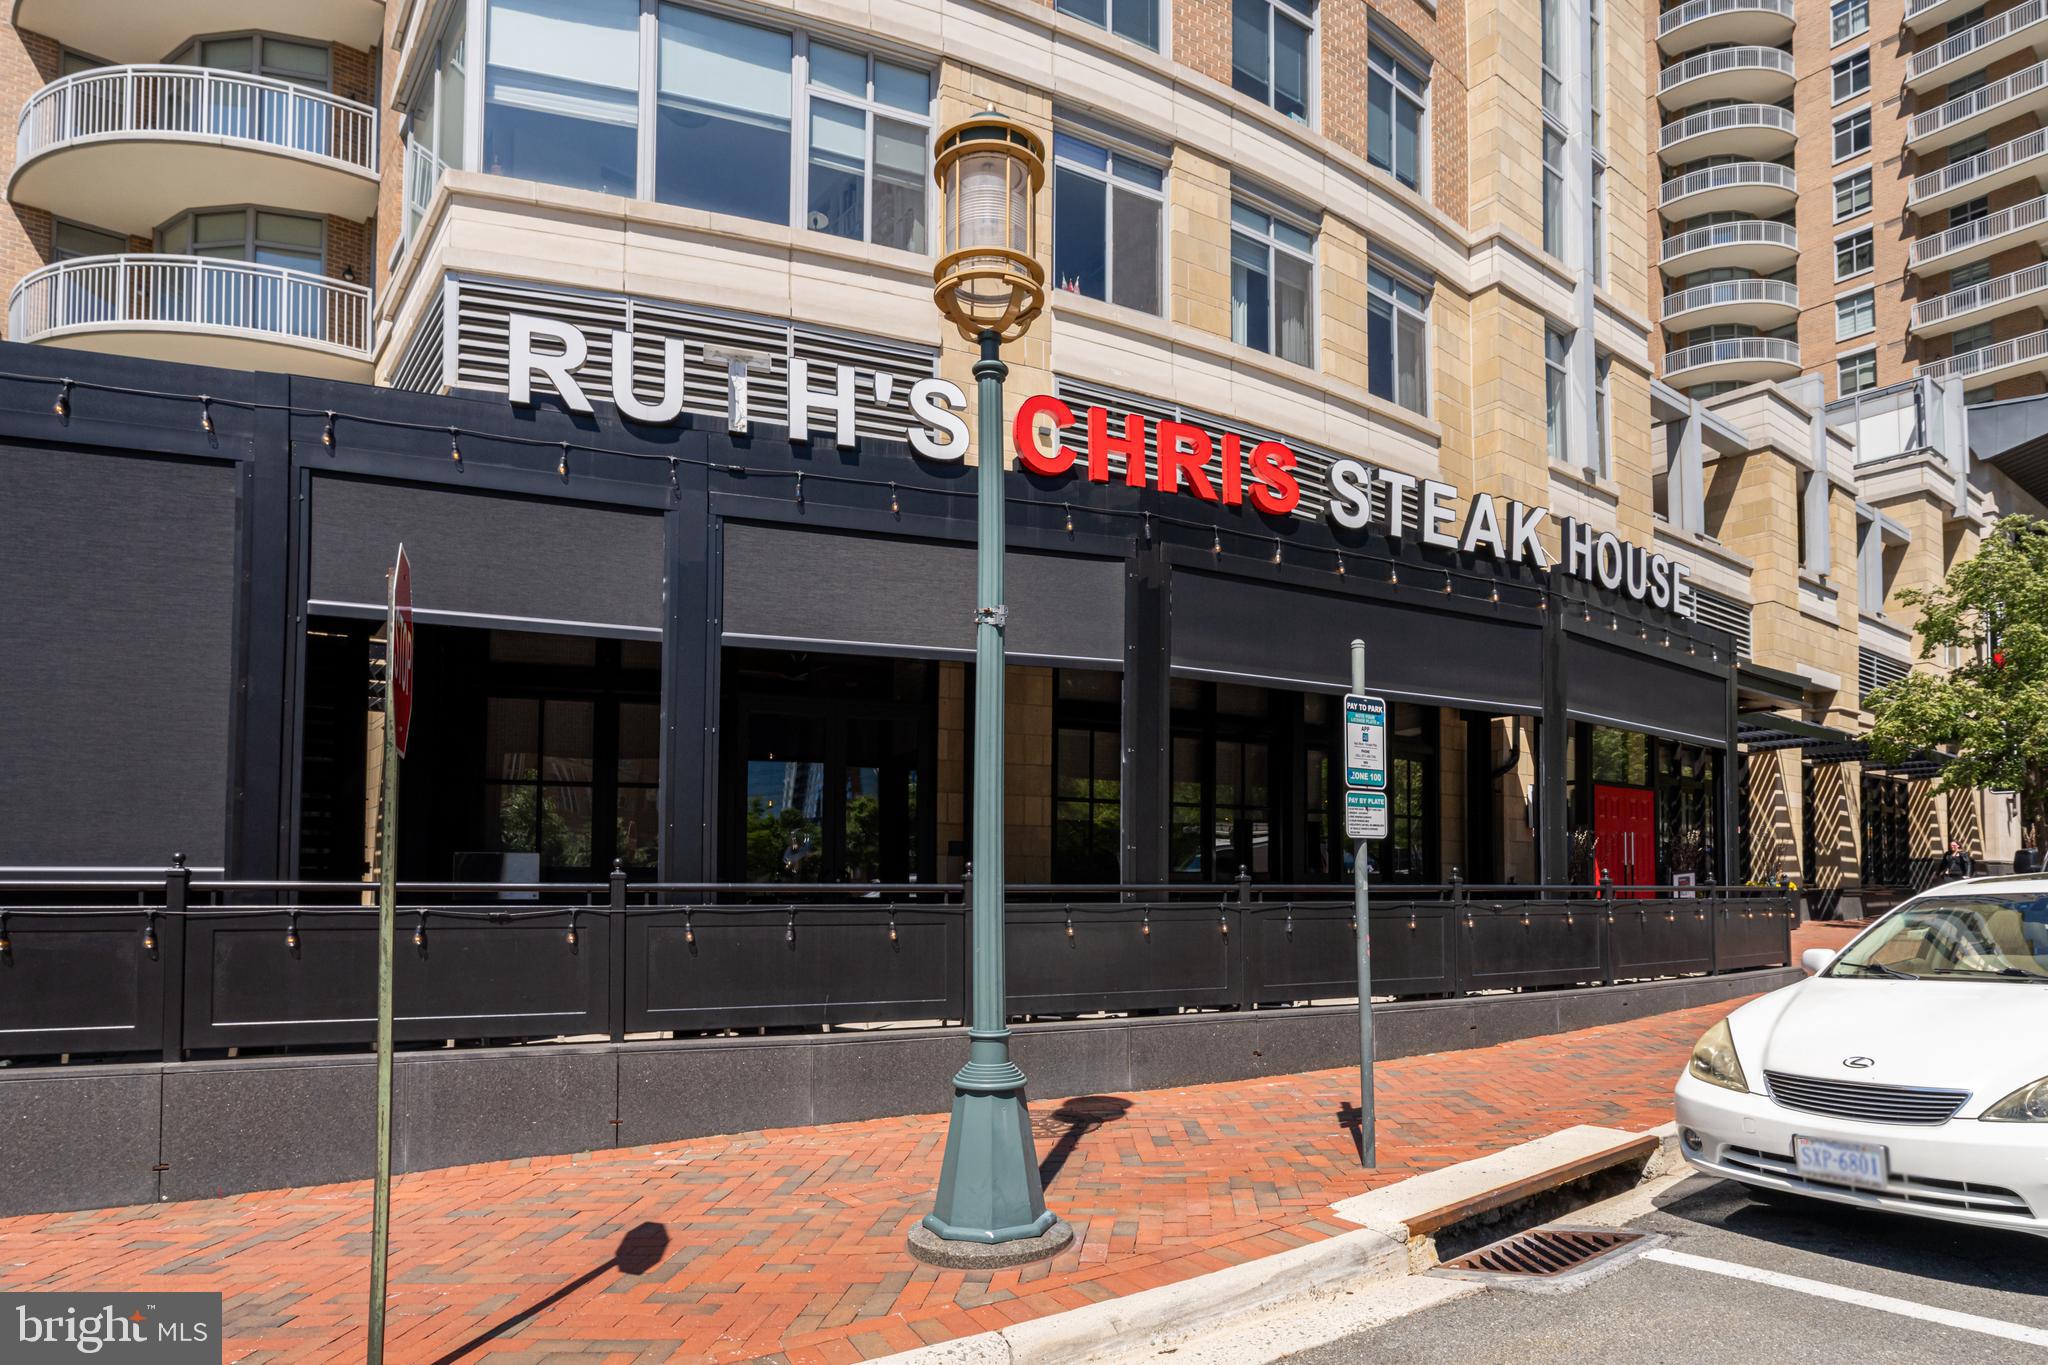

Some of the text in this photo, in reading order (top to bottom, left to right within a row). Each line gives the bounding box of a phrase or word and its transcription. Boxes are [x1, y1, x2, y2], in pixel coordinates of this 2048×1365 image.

[508, 313, 1692, 617] RUTH'S CHRIS STEAK HOUSE
[394, 608, 412, 695] STOP
[1347, 702, 1358, 710] PAY
[1368, 705, 1383, 713] PARK
[1350, 771, 1382, 782] ZONE 100
[1802, 1147, 1878, 1175] SXP-6801
